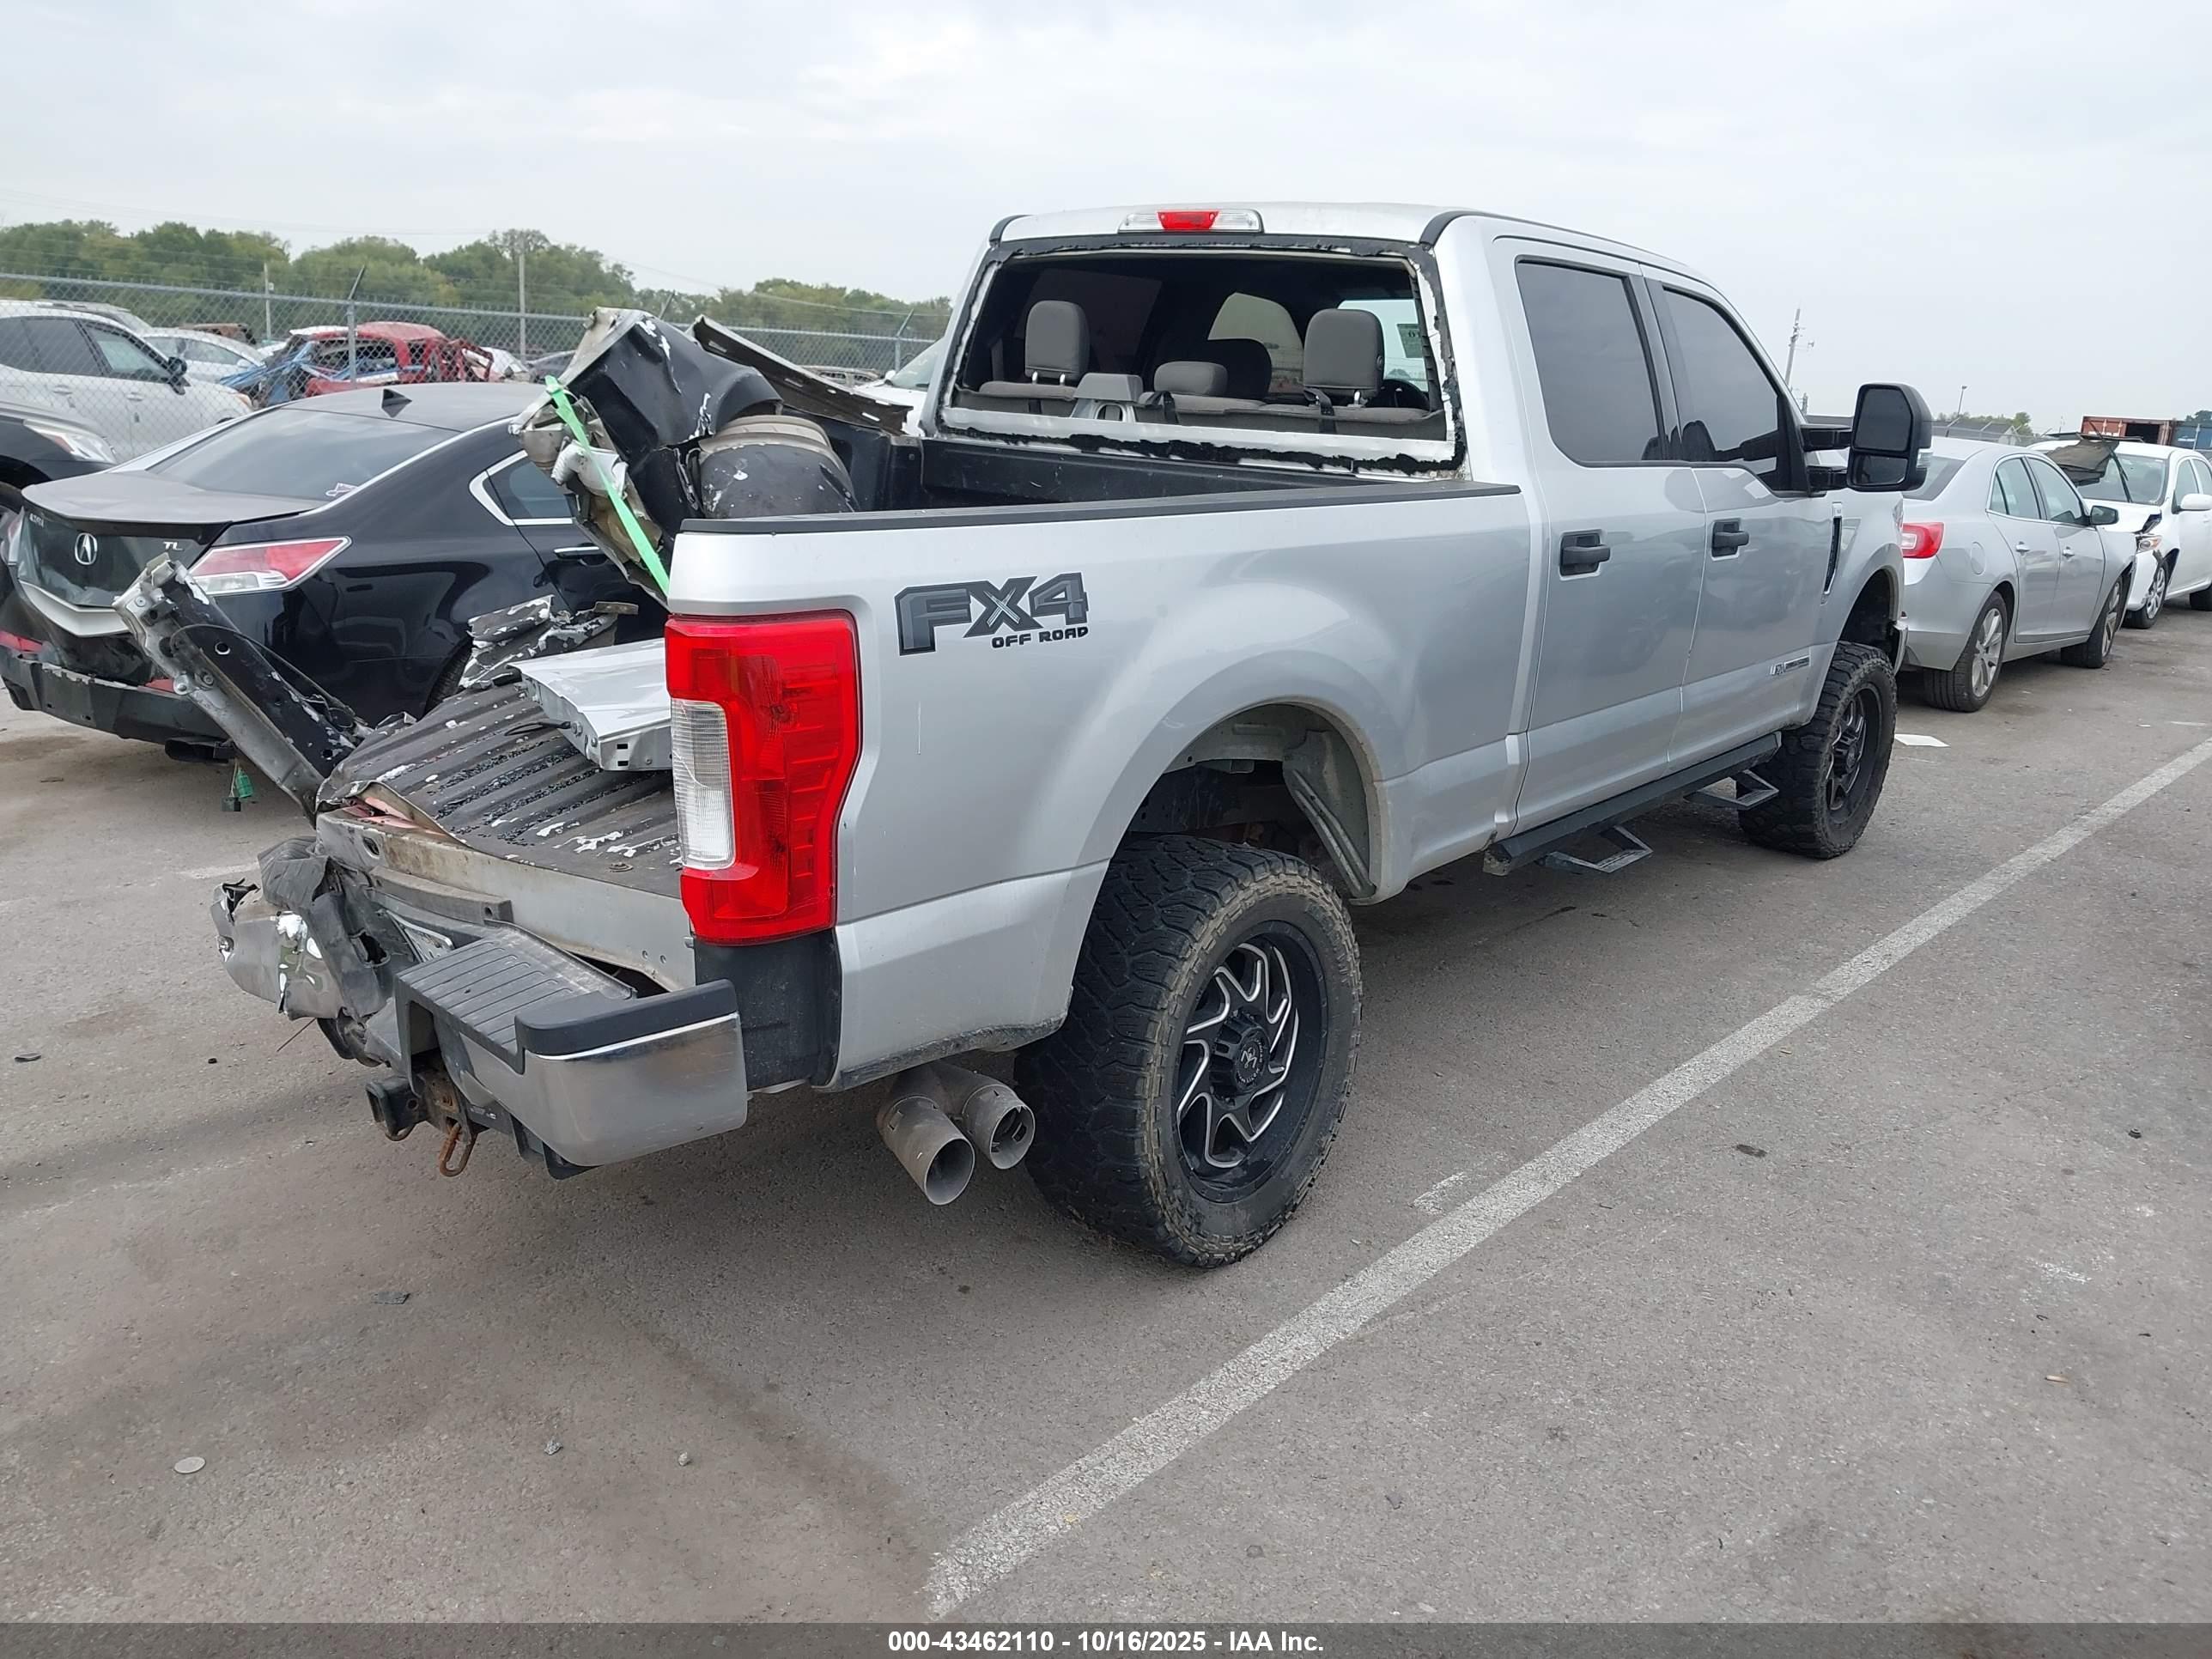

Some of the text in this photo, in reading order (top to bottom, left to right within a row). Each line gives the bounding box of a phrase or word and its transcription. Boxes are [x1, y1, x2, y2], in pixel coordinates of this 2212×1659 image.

[163, 541, 183, 550] TL
[894, 572, 1089, 656] FX4
[992, 626, 1089, 648] OFF ROAD
